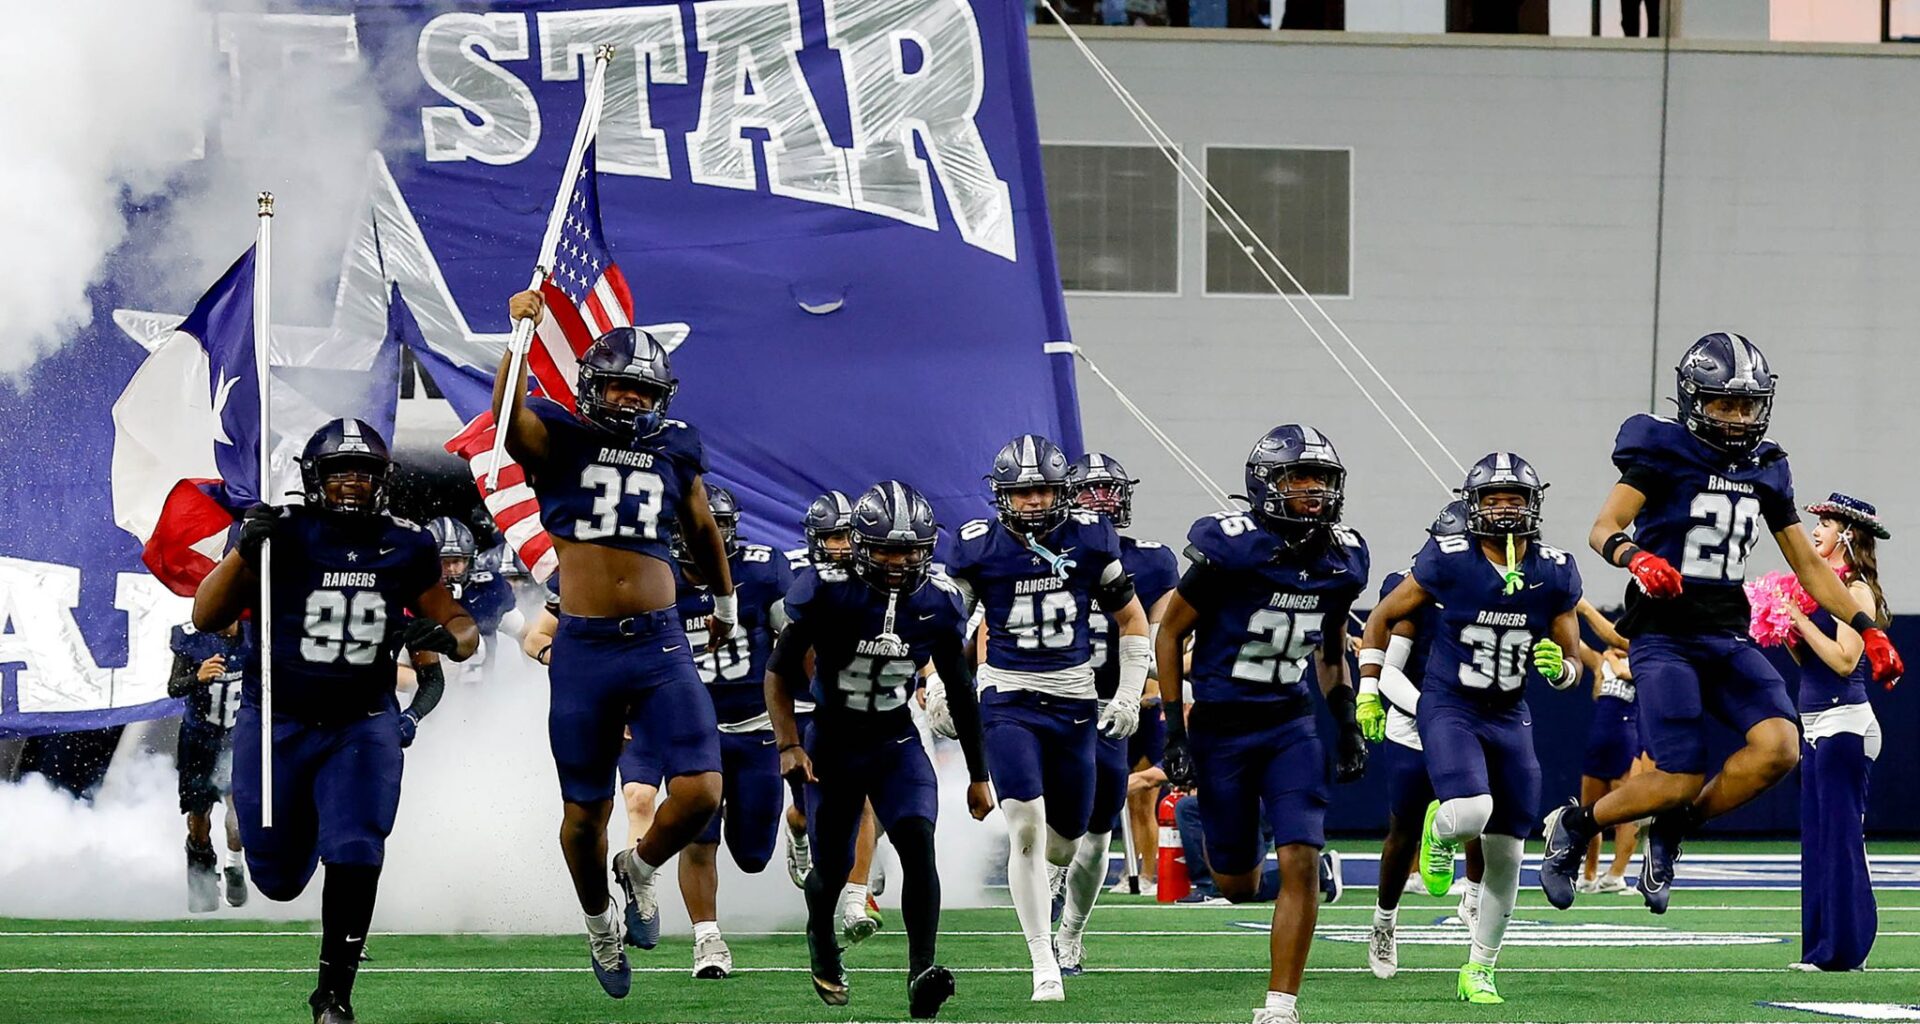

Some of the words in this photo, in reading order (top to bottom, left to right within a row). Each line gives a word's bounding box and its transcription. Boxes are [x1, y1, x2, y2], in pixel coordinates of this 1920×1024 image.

[417, 0, 1017, 262] STAR
[598, 447, 653, 468] RANGERS
[574, 464, 664, 540] 33
[1681, 493, 1760, 581] 20
[322, 572, 376, 588] RANGERS
[1015, 576, 1063, 595] RANGERS
[1269, 592, 1320, 610] RANGERS
[300, 590, 388, 665] 99
[1005, 591, 1078, 649] 40
[1231, 609, 1326, 684] 25
[1477, 610, 1527, 627] RANGERS
[1458, 624, 1533, 692] 30
